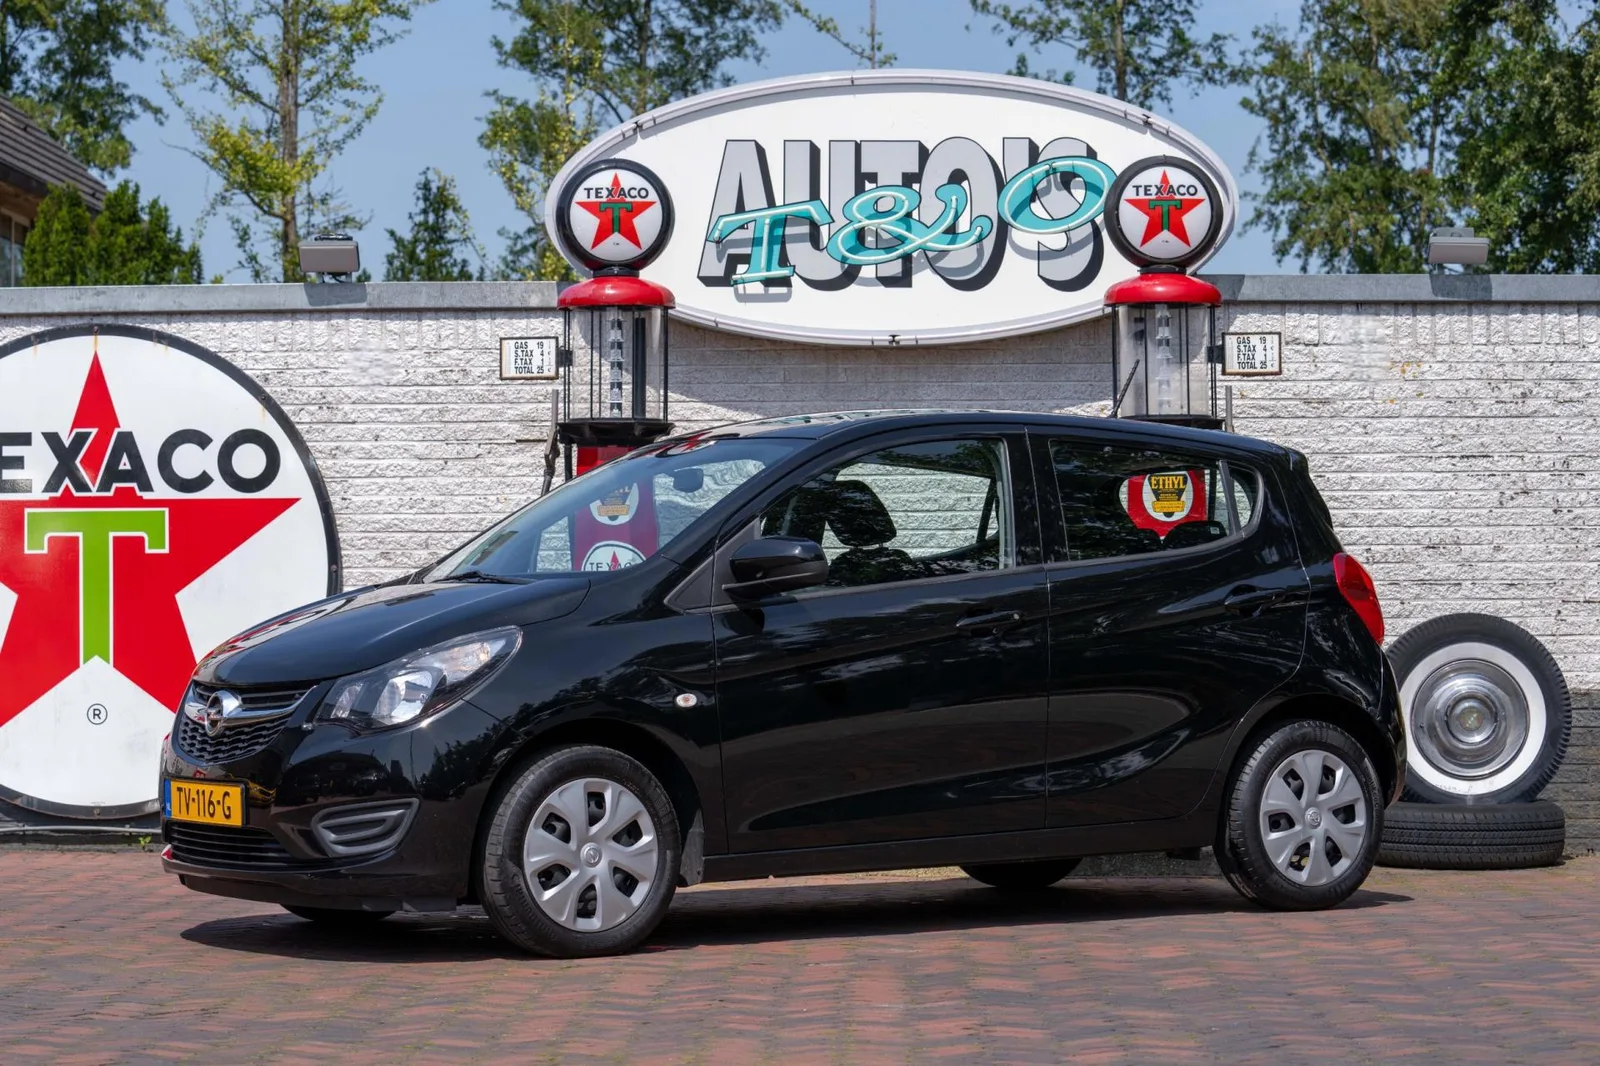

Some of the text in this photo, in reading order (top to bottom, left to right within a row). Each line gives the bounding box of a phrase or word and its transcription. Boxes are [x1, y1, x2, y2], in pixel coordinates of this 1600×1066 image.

[584, 187, 649, 199] TEXACO
[1132, 184, 1198, 196] TEXACO
[599, 201, 633, 234] T
[697, 136, 1104, 292] AUTO'S
[1148, 199, 1182, 232] T
[514, 341, 544, 349] GAS 19
[1236, 336, 1267, 344] GAS 19
[1237, 353, 1255, 361] F.TAX
[536, 366, 544, 374] 25
[1260, 361, 1267, 369] 25
[1150, 476, 1186, 489] ETHYL
[25, 509, 168, 665] T
[176, 786, 232, 820] TV-116-G
